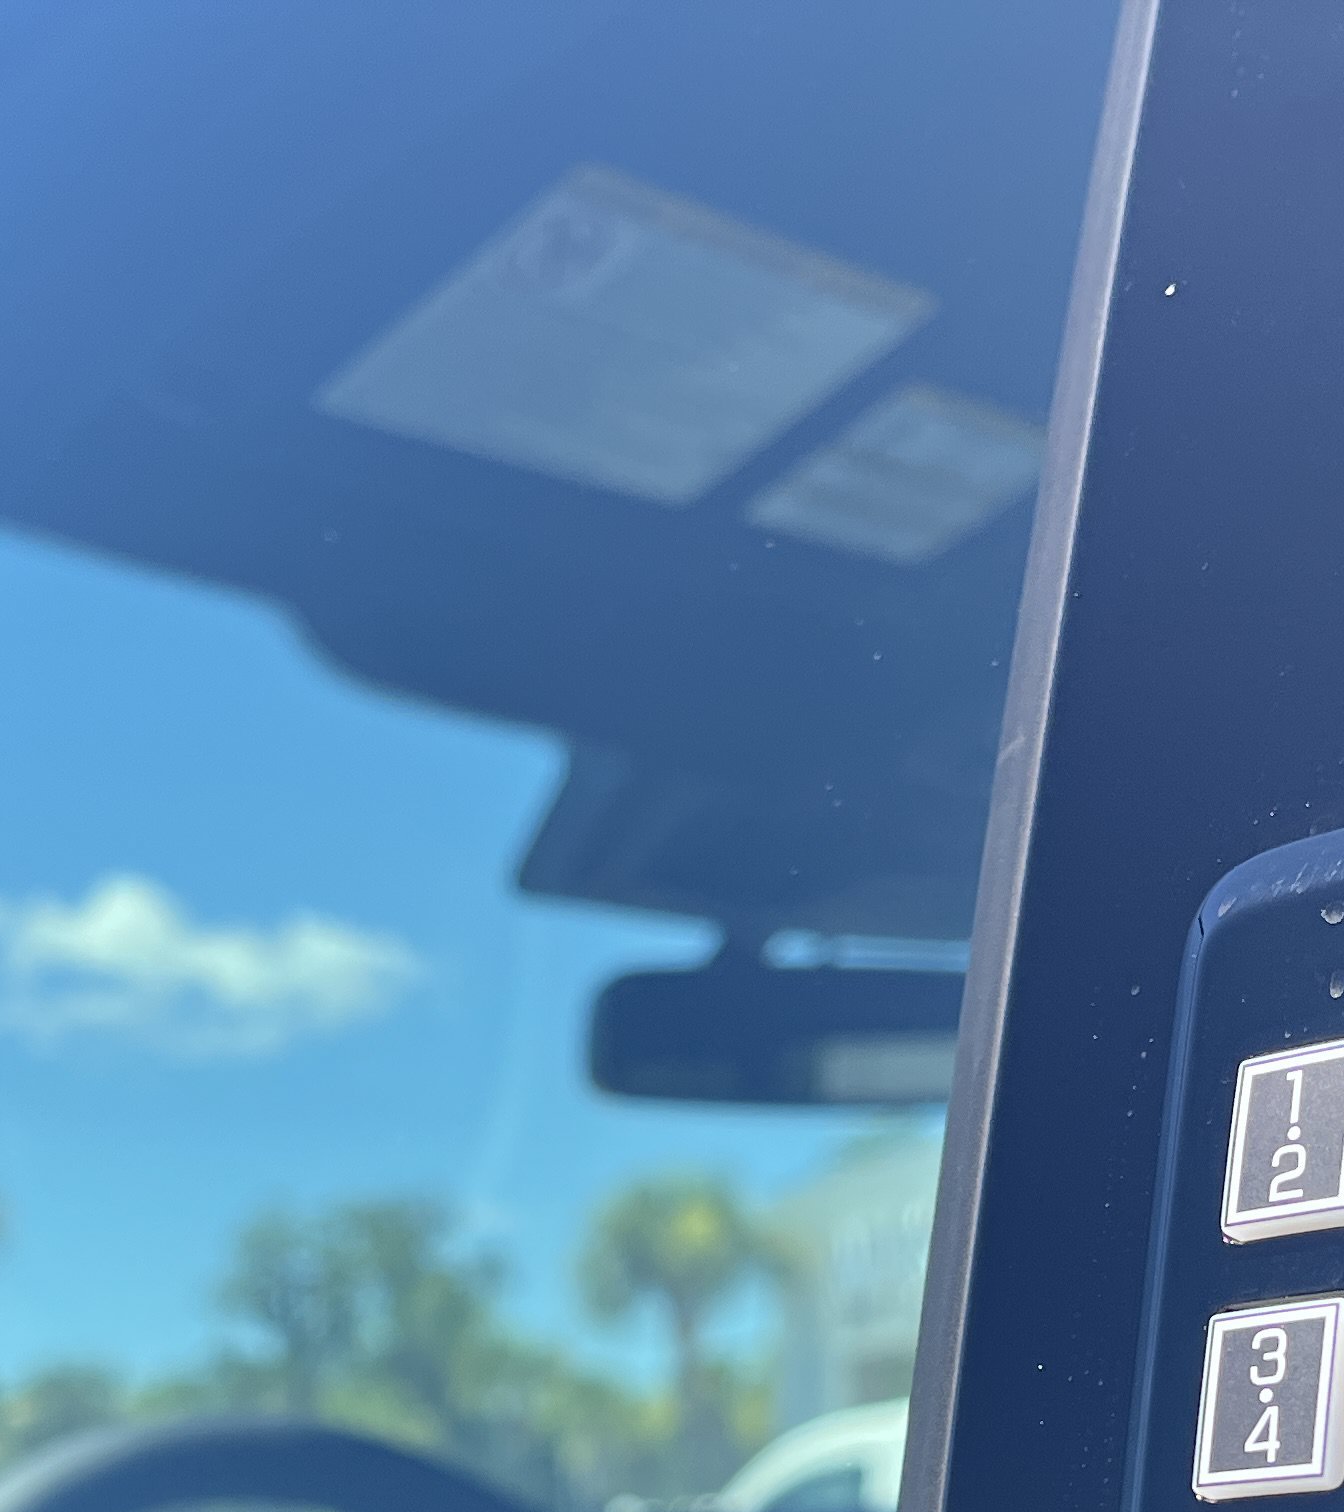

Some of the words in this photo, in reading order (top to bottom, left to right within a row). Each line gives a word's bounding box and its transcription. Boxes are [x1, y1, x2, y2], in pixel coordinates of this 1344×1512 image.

[1284, 1070, 1303, 1125] 1
[1268, 1143, 1311, 1203] 2
[1249, 1327, 1289, 1387] 3
[1243, 1405, 1281, 1464] 4
